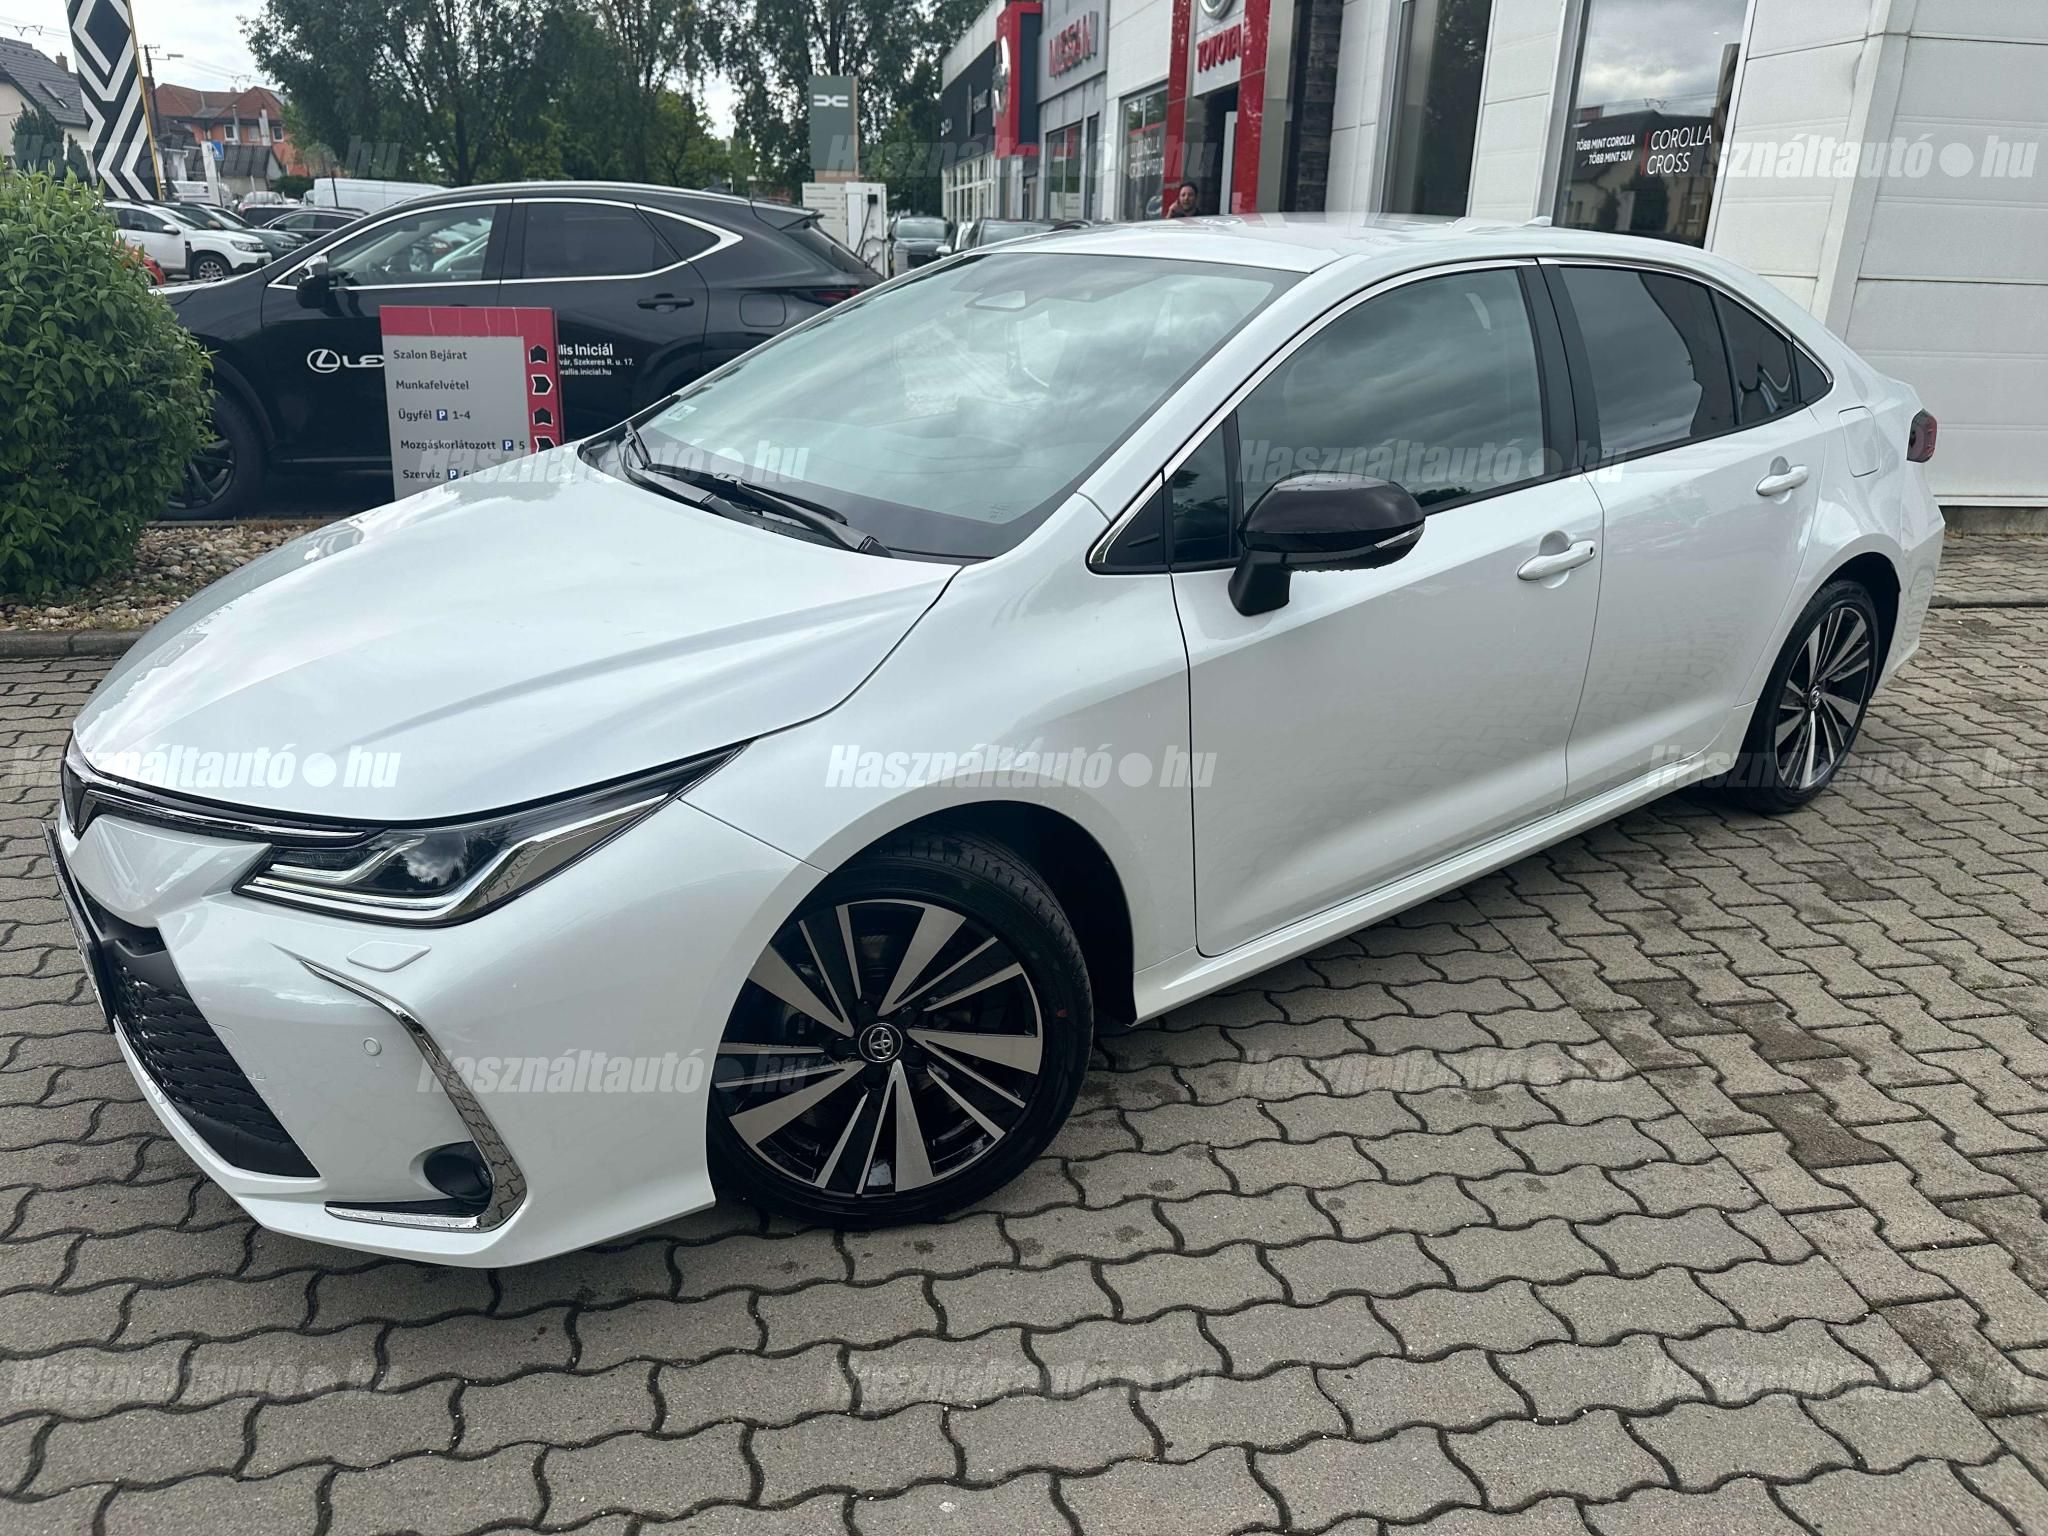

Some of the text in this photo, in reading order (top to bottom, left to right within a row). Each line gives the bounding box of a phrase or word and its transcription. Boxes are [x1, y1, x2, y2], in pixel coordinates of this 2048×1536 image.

[1197, 24, 1242, 73] TOYOTA
[1591, 137, 1606, 149] MINT
[1606, 134, 1635, 147] COROLLA
[1650, 124, 1712, 150] COROLLA
[1604, 151, 1620, 162] MINT
[1620, 150, 1634, 161] SUV
[1646, 152, 1692, 175] CROSS
[393, 349, 467, 362] Szalon Bejárat
[575, 343, 614, 356] Iniciál
[396, 380, 469, 391] Munkafelvétel
[398, 408, 432, 421] Ügyfél
[453, 410, 471, 420] 1-4
[400, 440, 496, 451] Mozgáskorlátozott
[518, 440, 525, 450] 5
[402, 469, 441, 479] Szerviz
